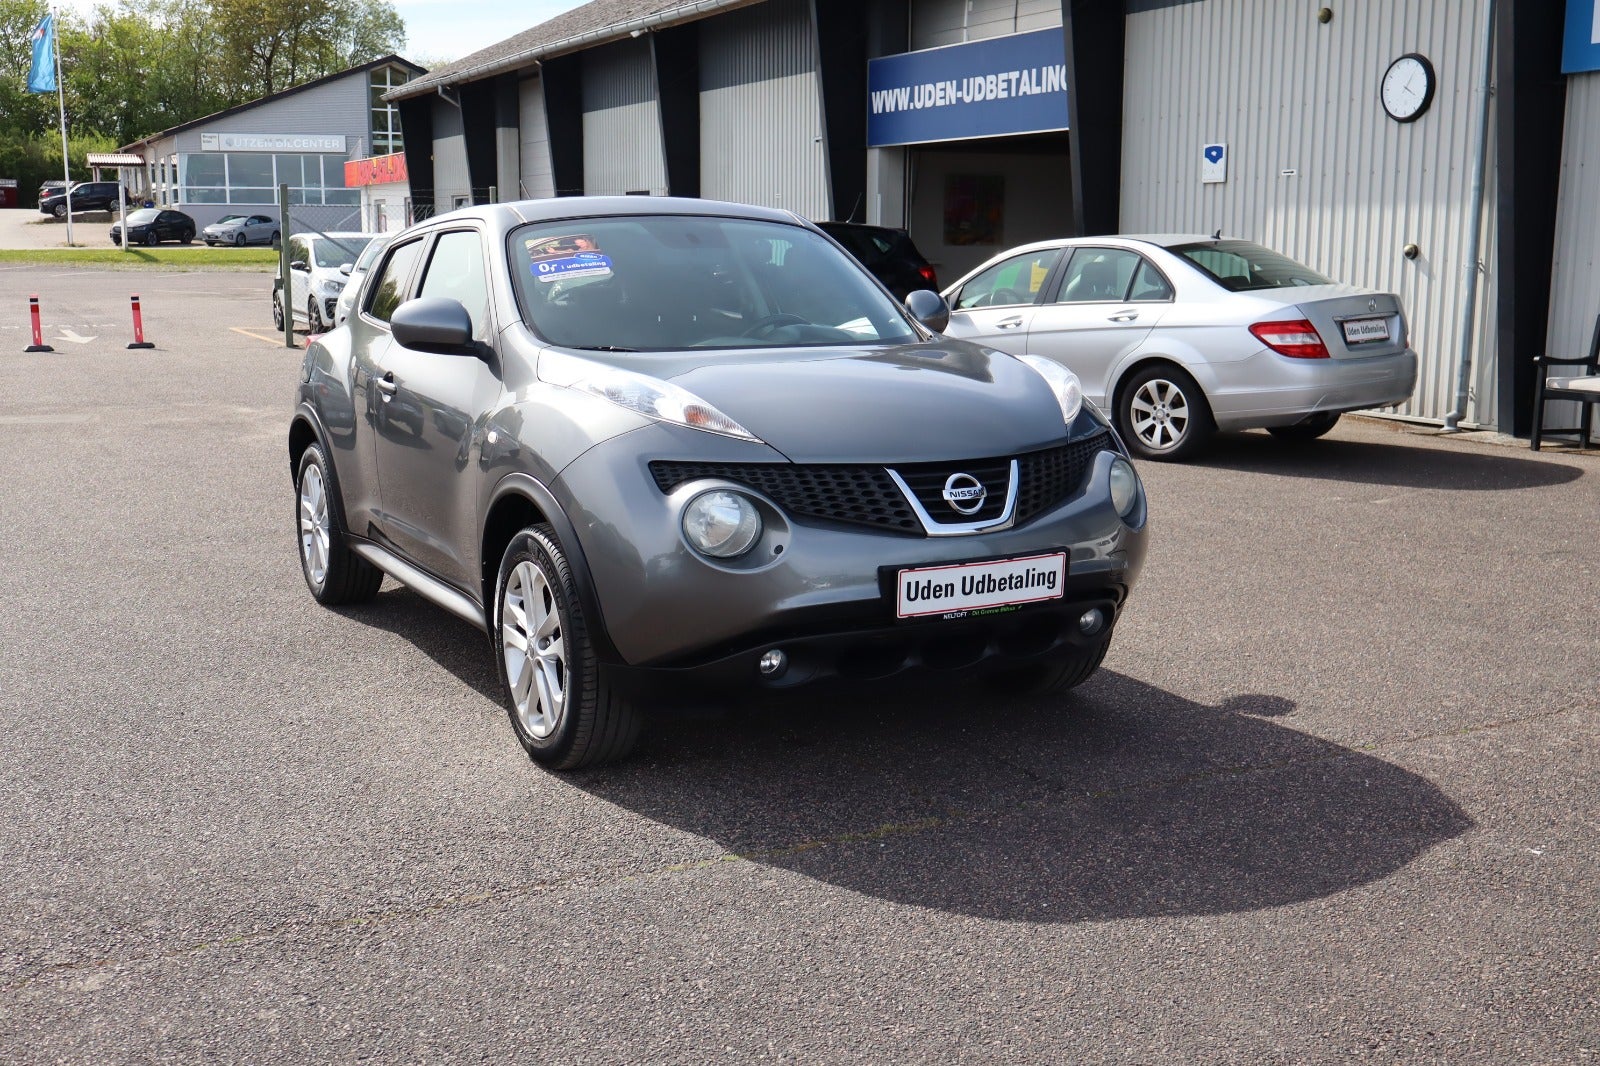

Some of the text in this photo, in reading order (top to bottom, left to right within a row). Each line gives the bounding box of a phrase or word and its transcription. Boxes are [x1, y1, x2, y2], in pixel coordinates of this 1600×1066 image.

[949, 486, 985, 499] NISSAN
[906, 567, 1057, 602] Uden Udbetaling
